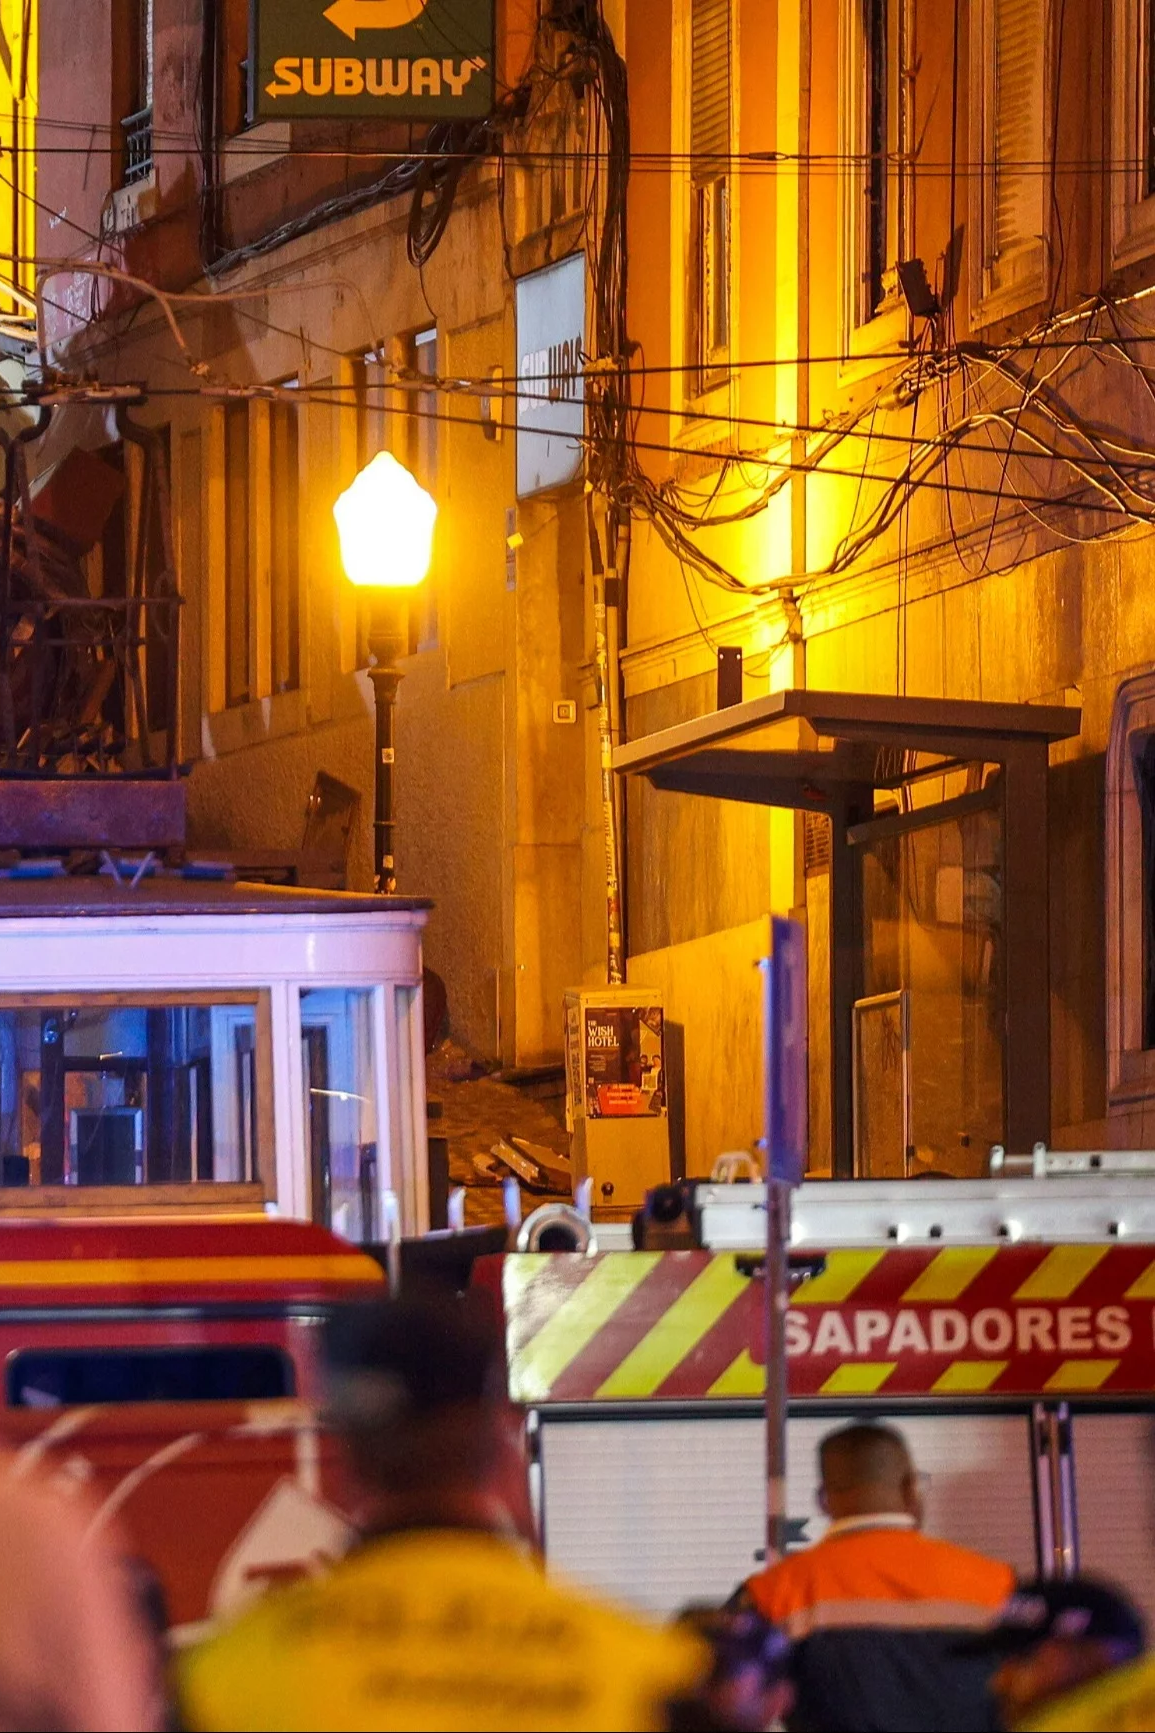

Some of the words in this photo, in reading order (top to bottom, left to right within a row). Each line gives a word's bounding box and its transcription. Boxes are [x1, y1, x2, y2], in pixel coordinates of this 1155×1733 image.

[265, 56, 486, 97] SUBWAY
[588, 1025, 613, 1037] WISH
[588, 1036, 619, 1047] HOTEL
[784, 1306, 1133, 1355] SAPADORES
